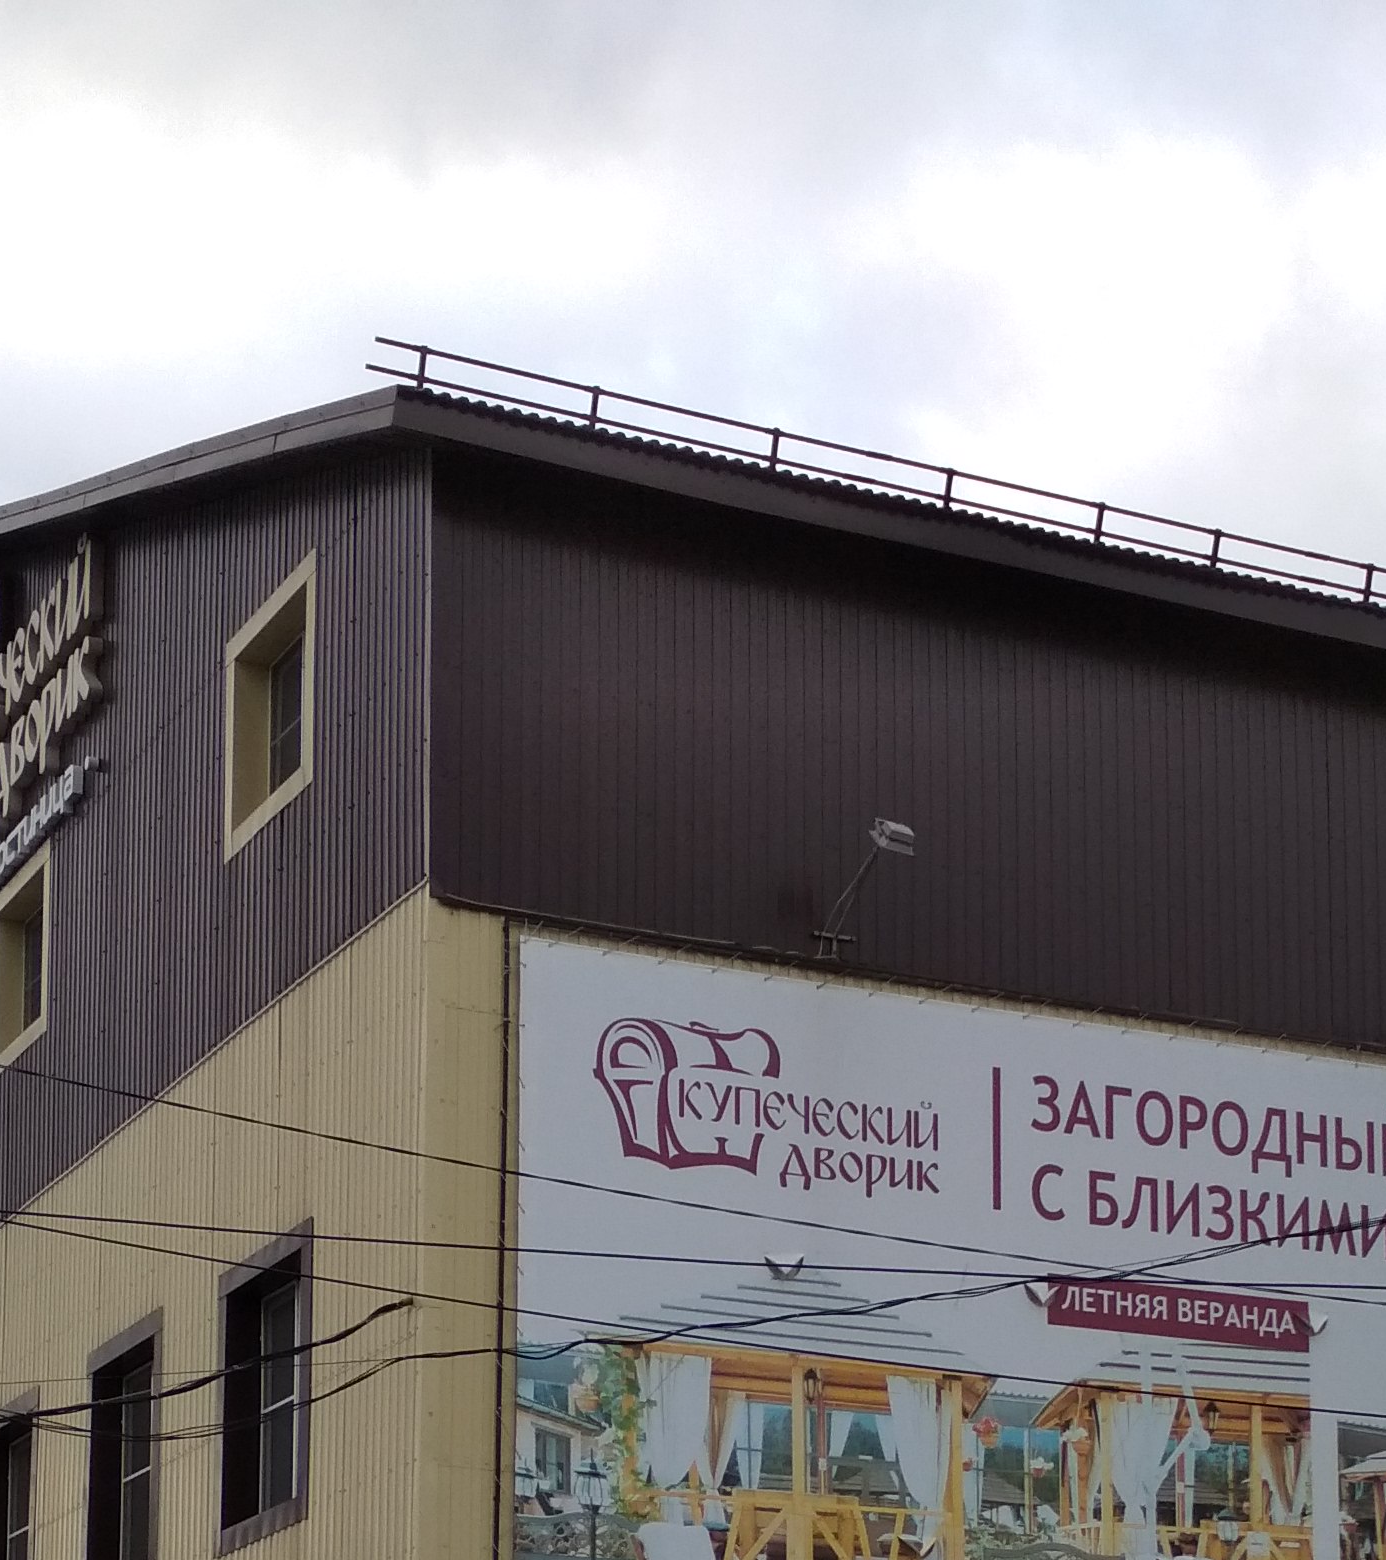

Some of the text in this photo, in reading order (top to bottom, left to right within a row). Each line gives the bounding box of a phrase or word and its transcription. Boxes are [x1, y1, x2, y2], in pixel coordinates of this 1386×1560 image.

[1031, 1163, 1066, 1222] С
[1060, 1285, 1297, 1339] ЛЕТНЯЯ ВЕРАНДА
